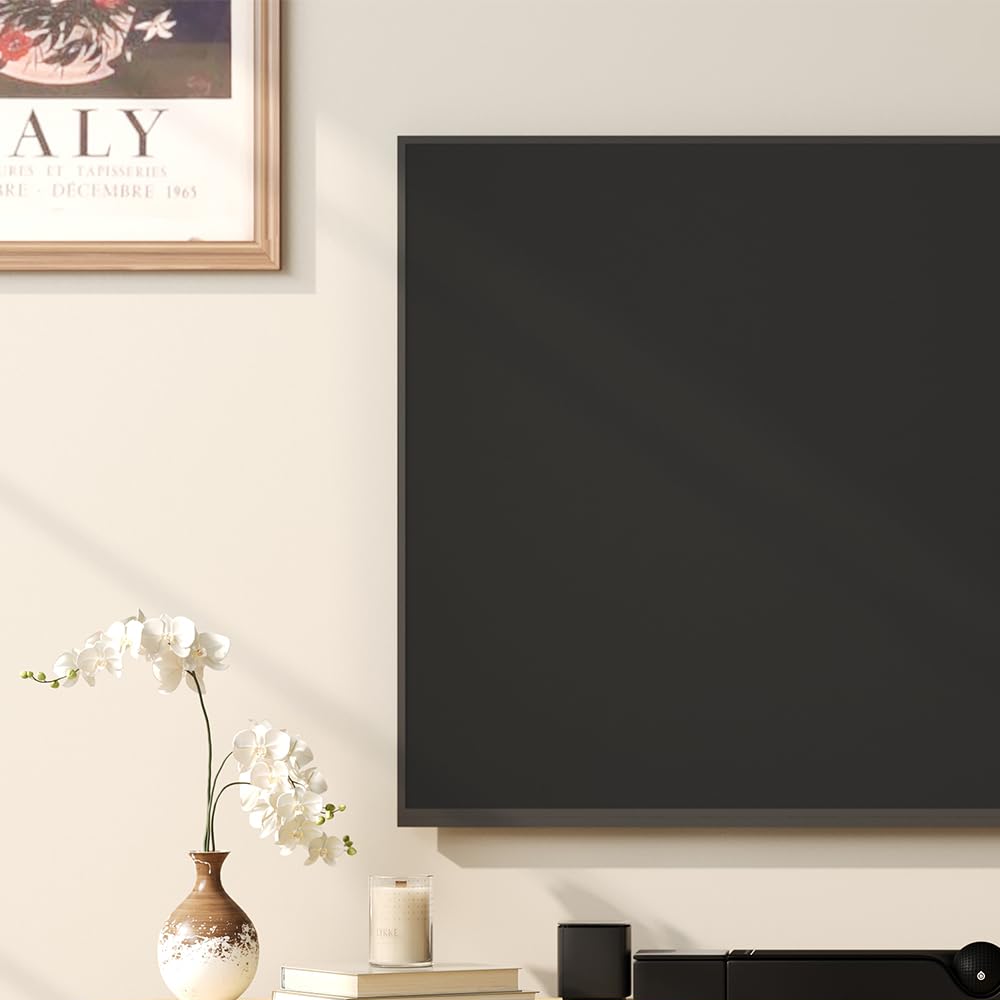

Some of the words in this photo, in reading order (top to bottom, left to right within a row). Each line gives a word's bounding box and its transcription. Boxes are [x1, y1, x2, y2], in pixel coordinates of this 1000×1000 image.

[8, 108, 169, 158] ALY
[77, 165, 168, 178] TAPISSERIES
[52, 182, 153, 199] DÉCEMBRE
[166, 185, 197, 199] 1965
